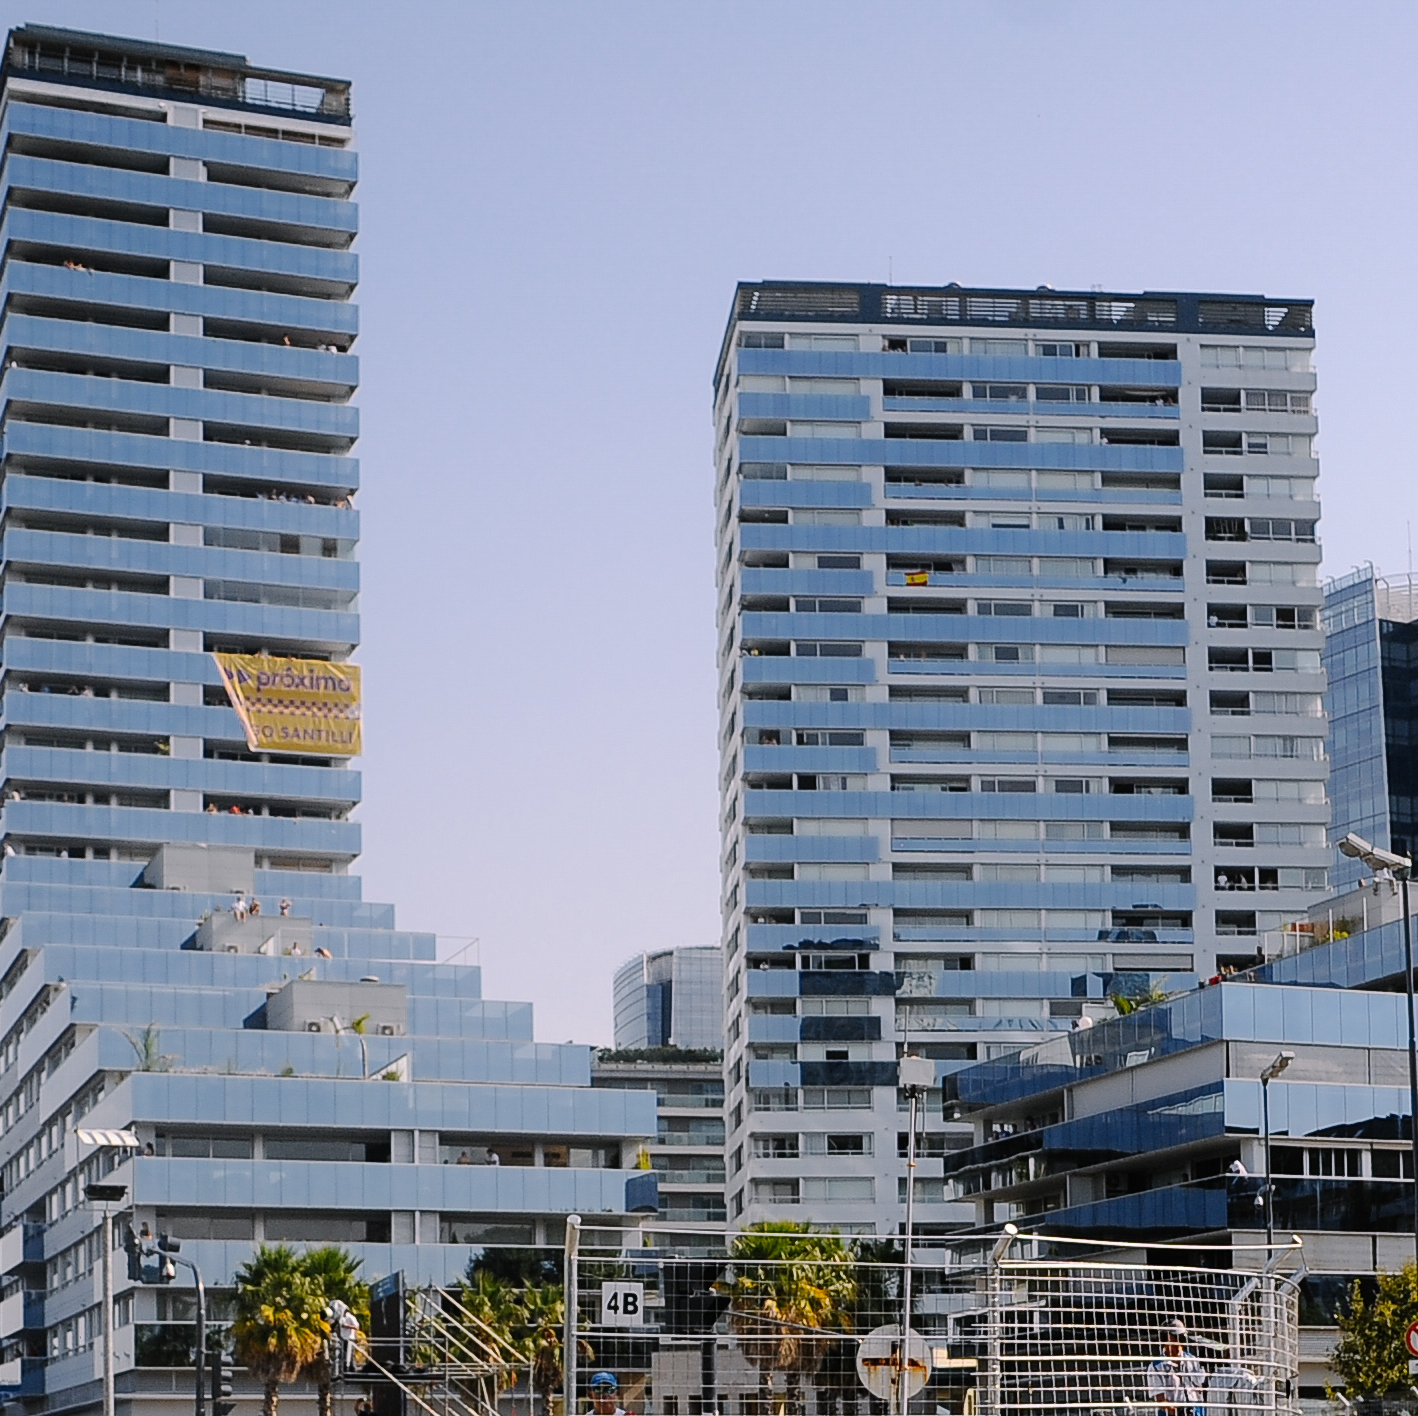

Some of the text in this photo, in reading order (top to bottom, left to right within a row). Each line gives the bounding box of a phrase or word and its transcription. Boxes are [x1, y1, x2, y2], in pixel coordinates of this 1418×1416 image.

[257, 667, 351, 692] próximo
[281, 726, 353, 744] SANTILLI
[607, 1292, 639, 1315] 4B
